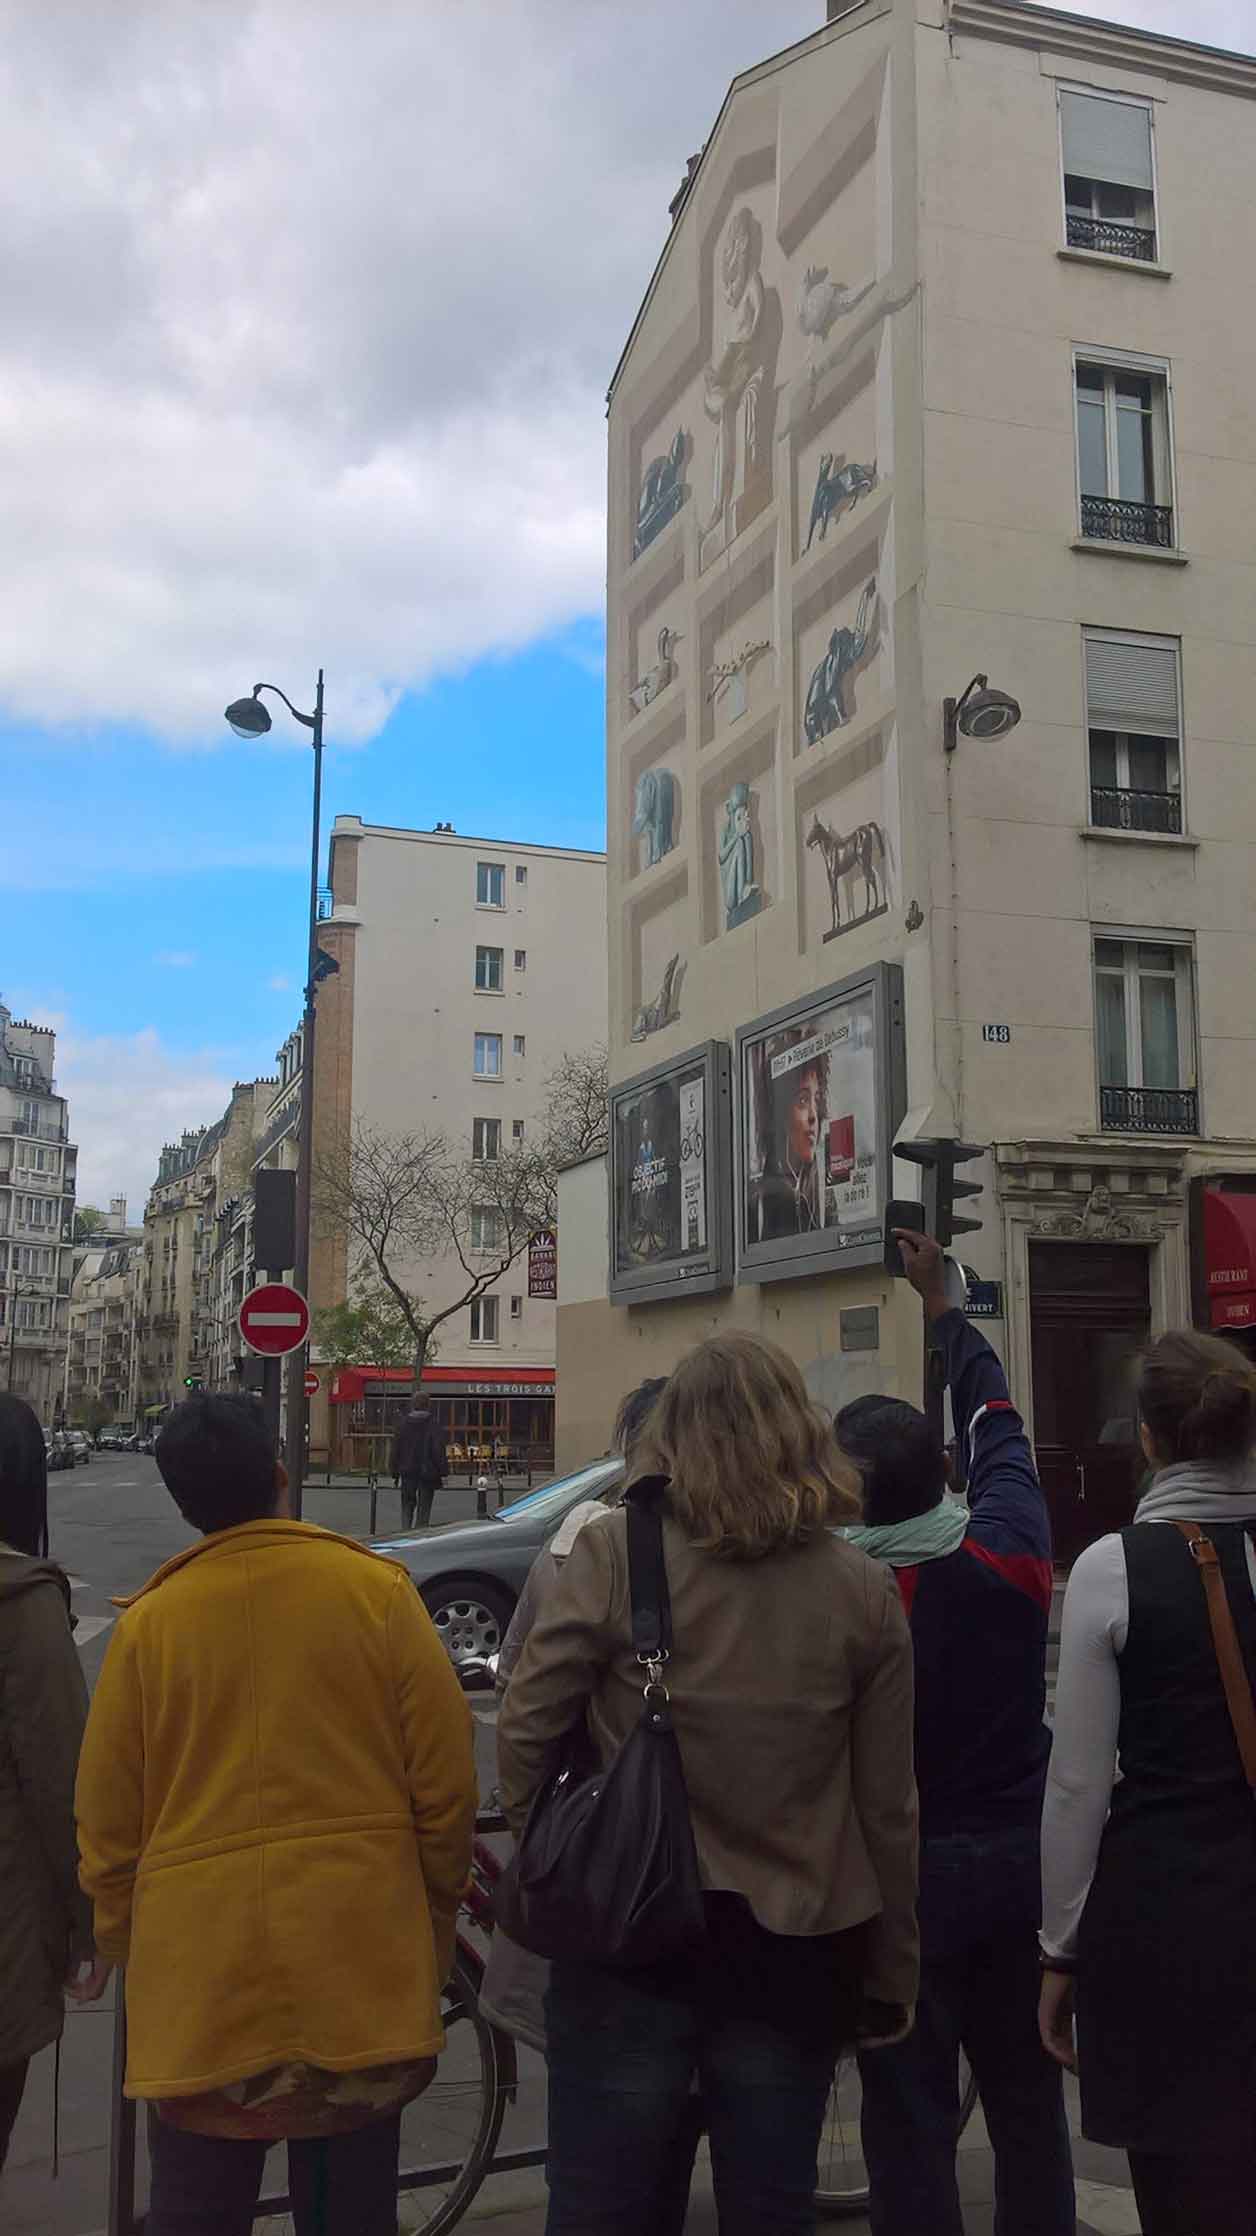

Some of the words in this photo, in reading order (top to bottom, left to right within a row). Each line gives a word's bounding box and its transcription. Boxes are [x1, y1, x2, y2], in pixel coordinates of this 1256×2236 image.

[985, 1025, 1008, 1041] 148
[468, 1384, 490, 1393] LES
[496, 1384, 531, 1393] TROIS
